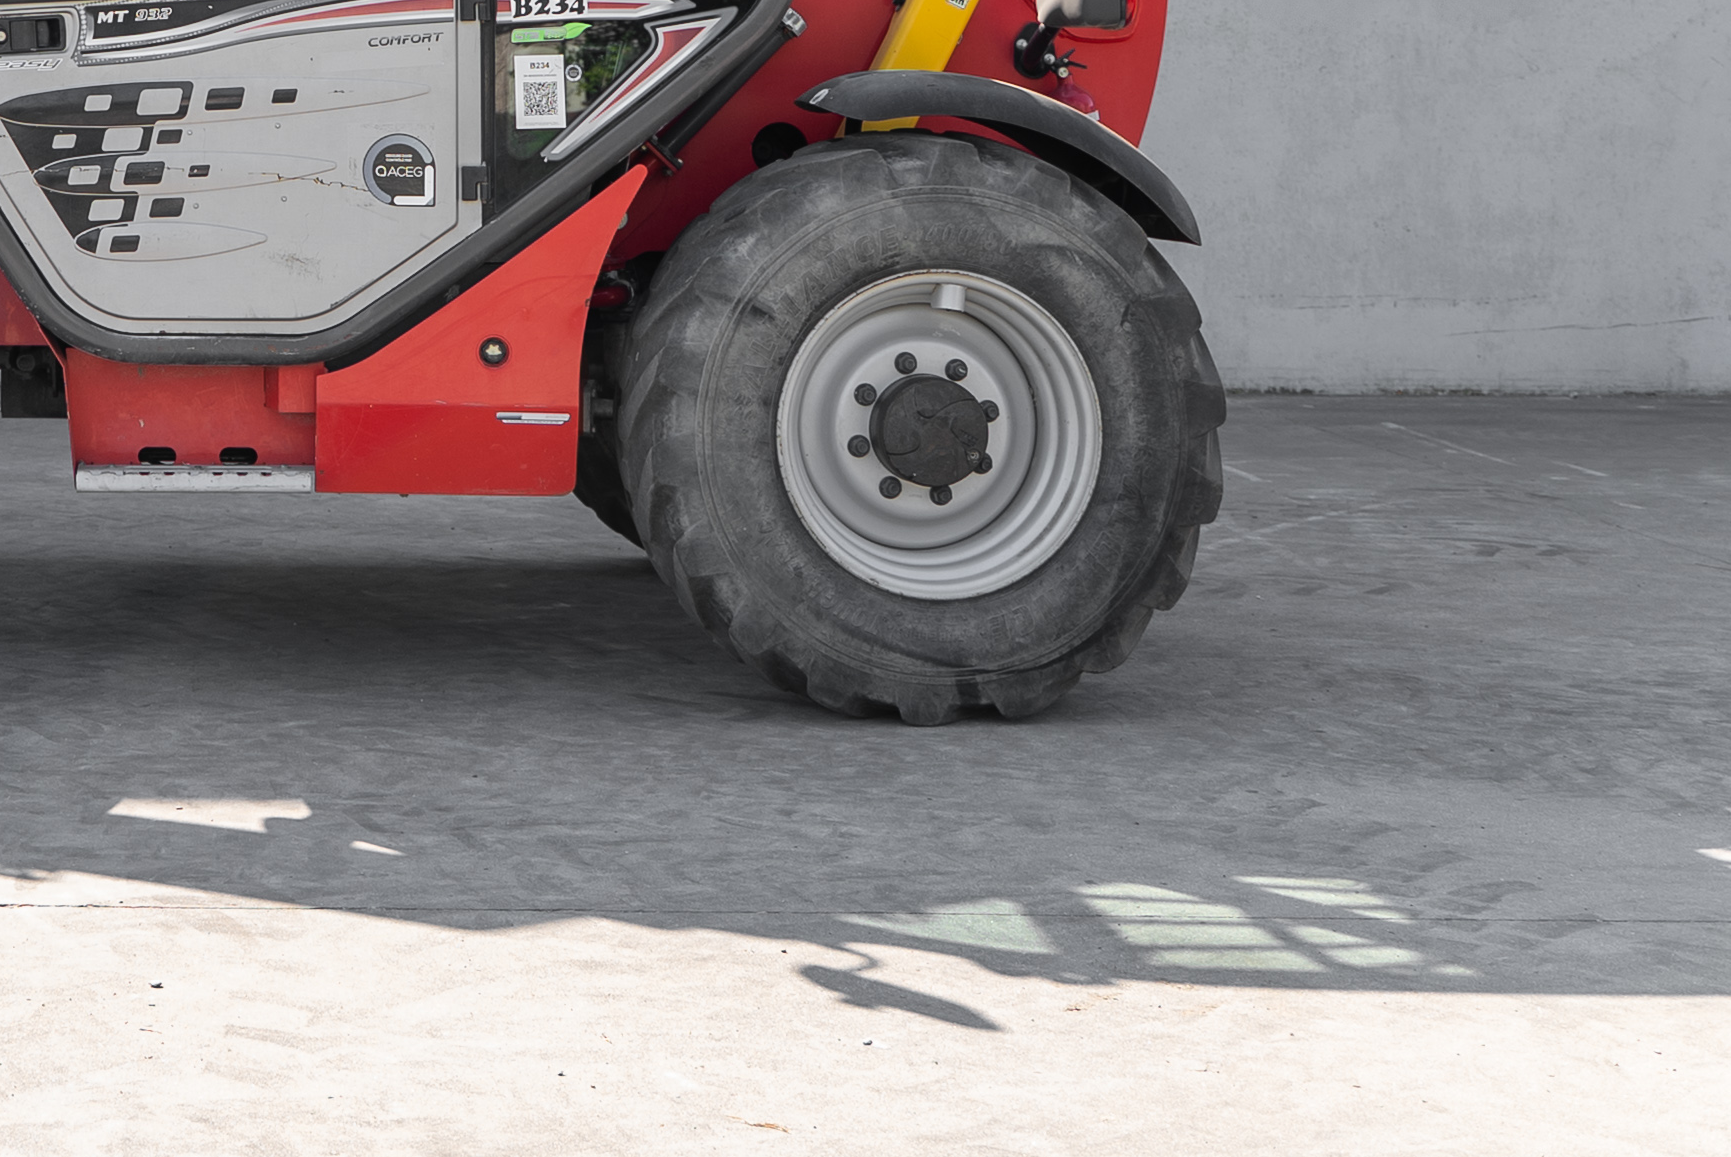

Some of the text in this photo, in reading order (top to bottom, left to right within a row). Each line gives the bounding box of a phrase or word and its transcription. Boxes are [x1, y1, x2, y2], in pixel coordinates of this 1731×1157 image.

[97, 7, 172, 24] MT 932
[368, 32, 444, 47] COMFORT
[730, 224, 902, 395] ALLIANCE
